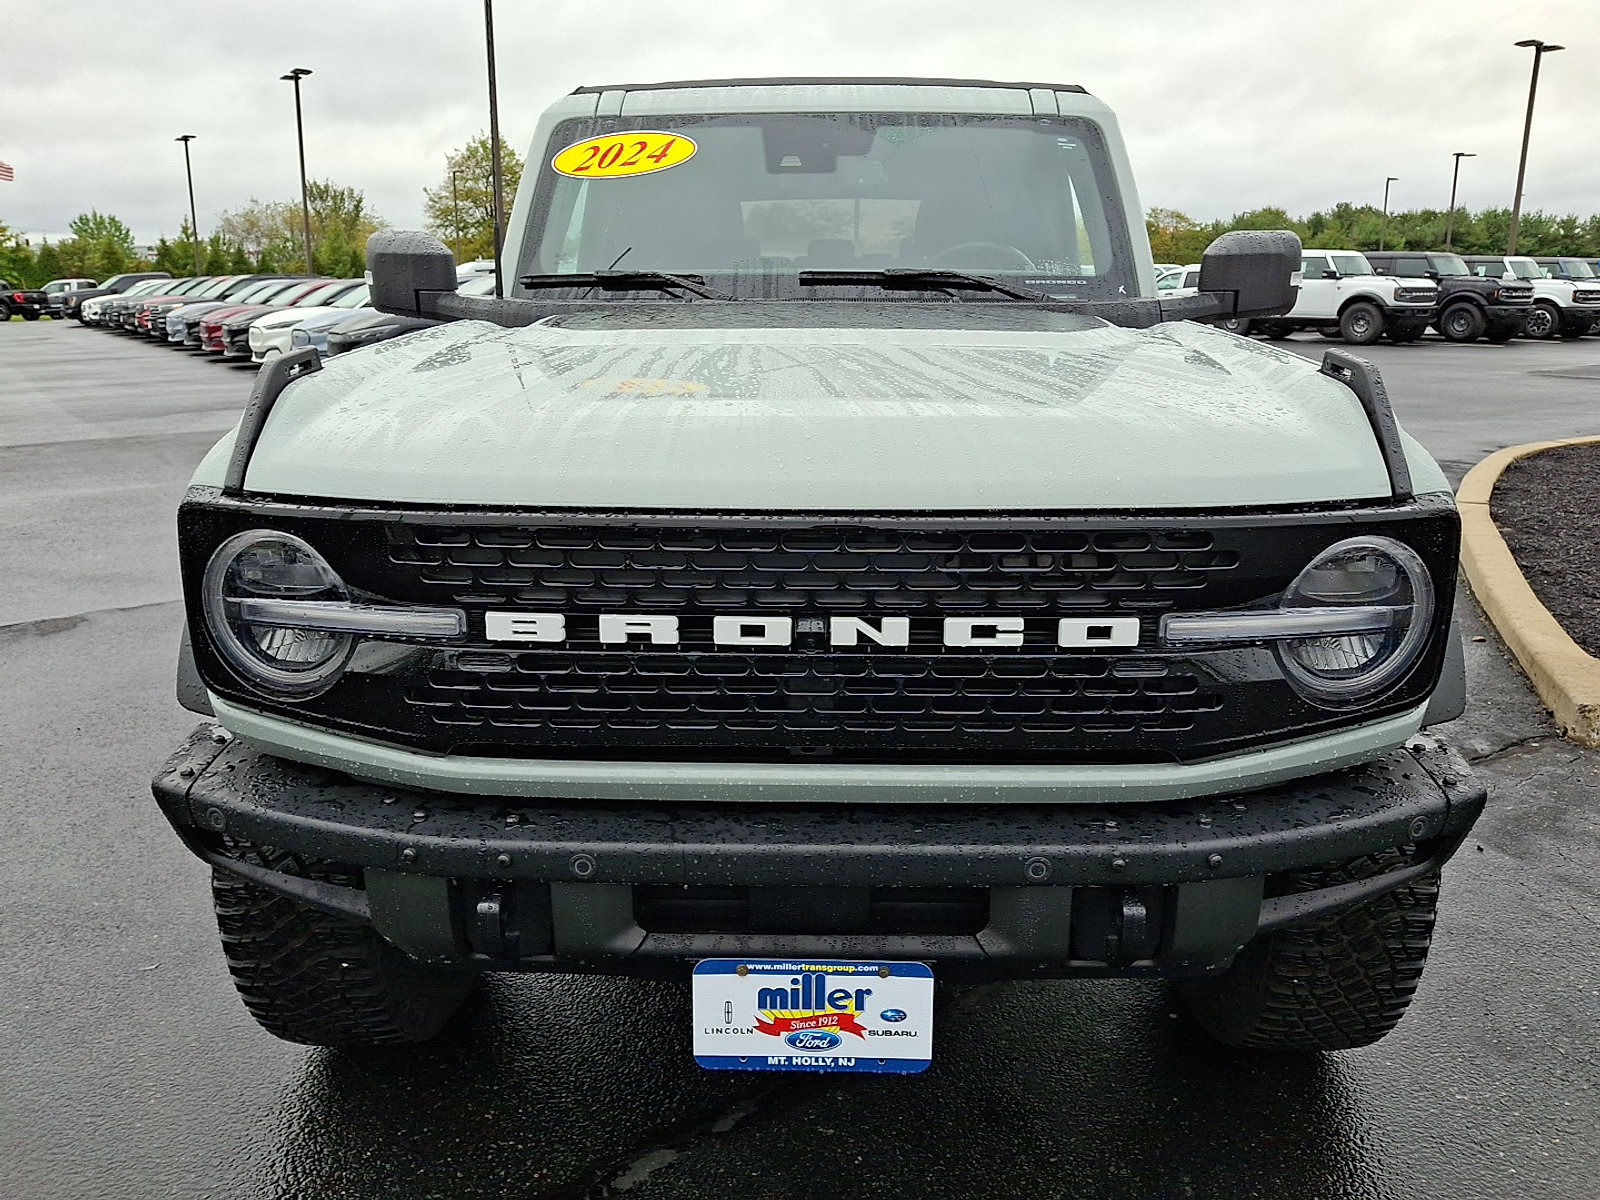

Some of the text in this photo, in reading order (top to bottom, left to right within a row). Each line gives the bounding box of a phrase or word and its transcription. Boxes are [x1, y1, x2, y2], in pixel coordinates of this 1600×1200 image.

[571, 137, 677, 173] 2024
[485, 610, 1140, 648] BRONCO
[746, 963, 879, 973] www.millertransgroup.com
[758, 973, 873, 1011] miller
[790, 1016, 839, 1030] Since 1912
[704, 1027, 754, 1035] LINCOLN
[796, 1032, 831, 1048] Ford
[767, 1056, 856, 1067] MT. HOLLY, NJ
